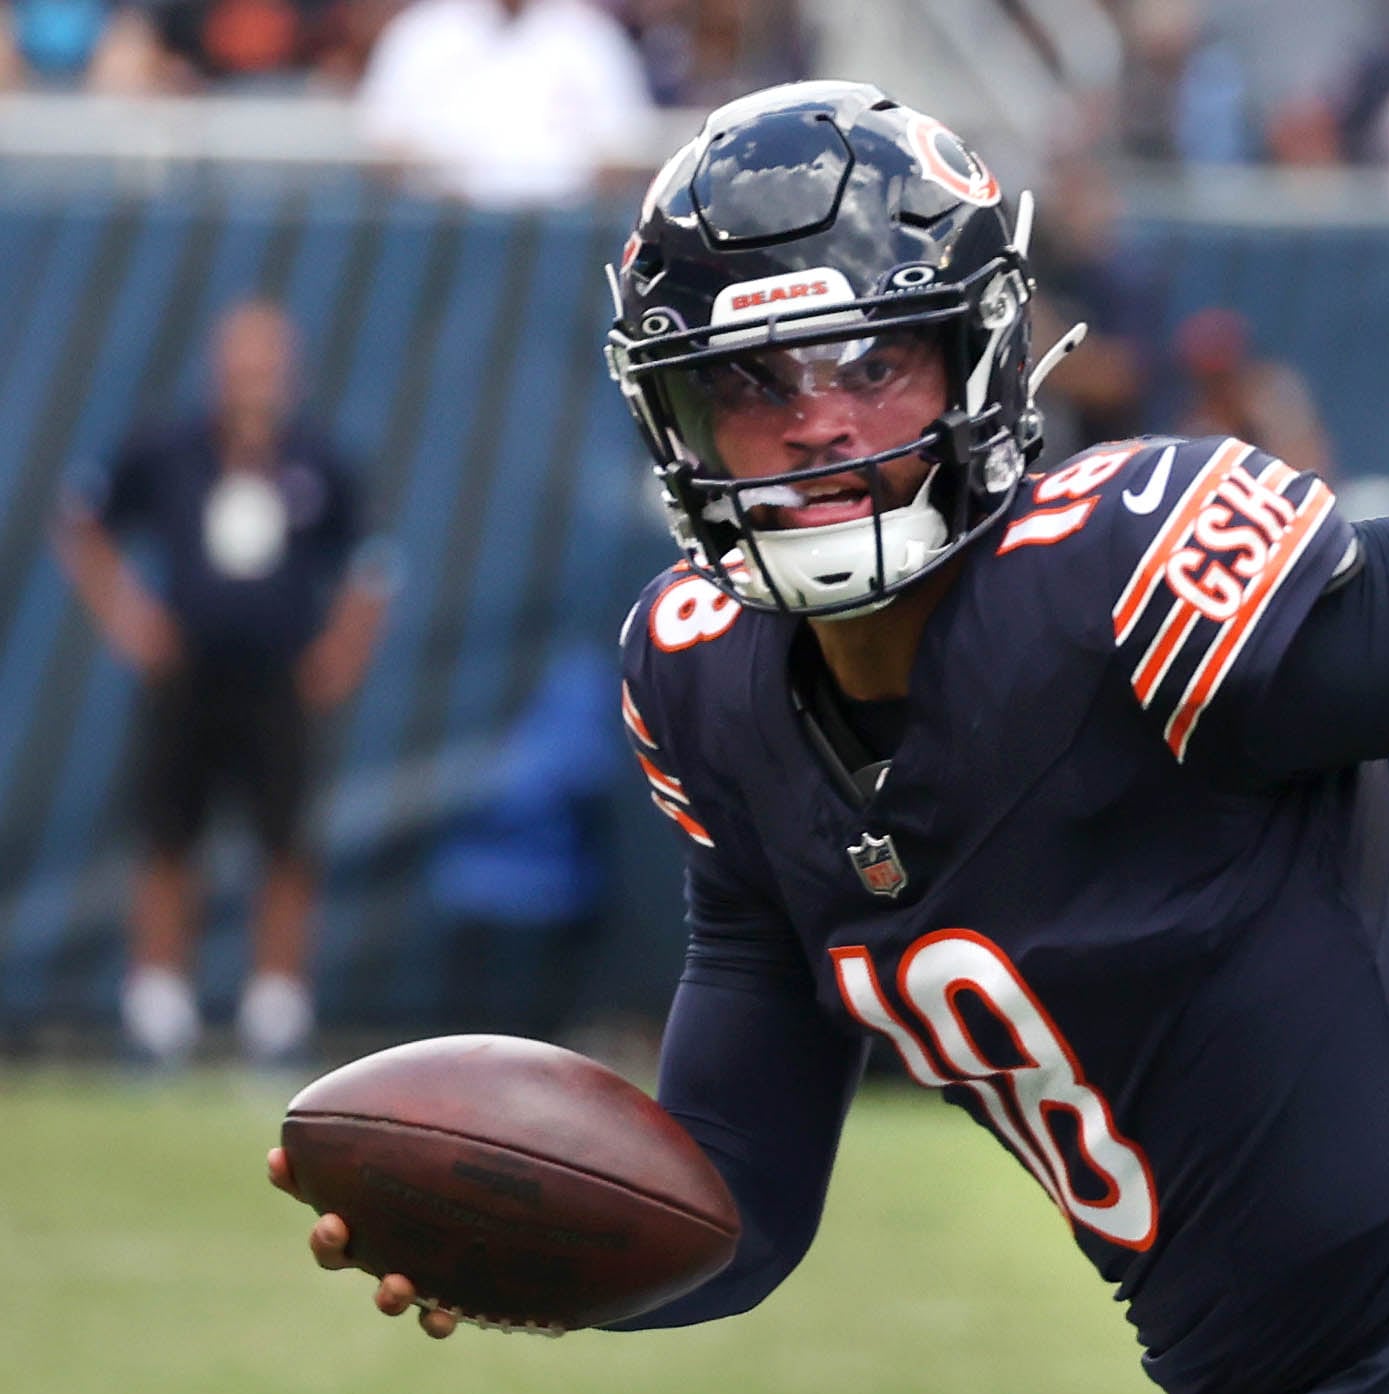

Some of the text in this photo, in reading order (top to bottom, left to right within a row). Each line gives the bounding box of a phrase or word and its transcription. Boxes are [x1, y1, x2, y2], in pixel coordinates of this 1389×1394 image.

[731, 280, 829, 311] BEARS
[995, 441, 1145, 557] 18
[1165, 463, 1297, 623] GSH
[648, 547, 751, 654] 8
[828, 927, 1159, 1253] 18
